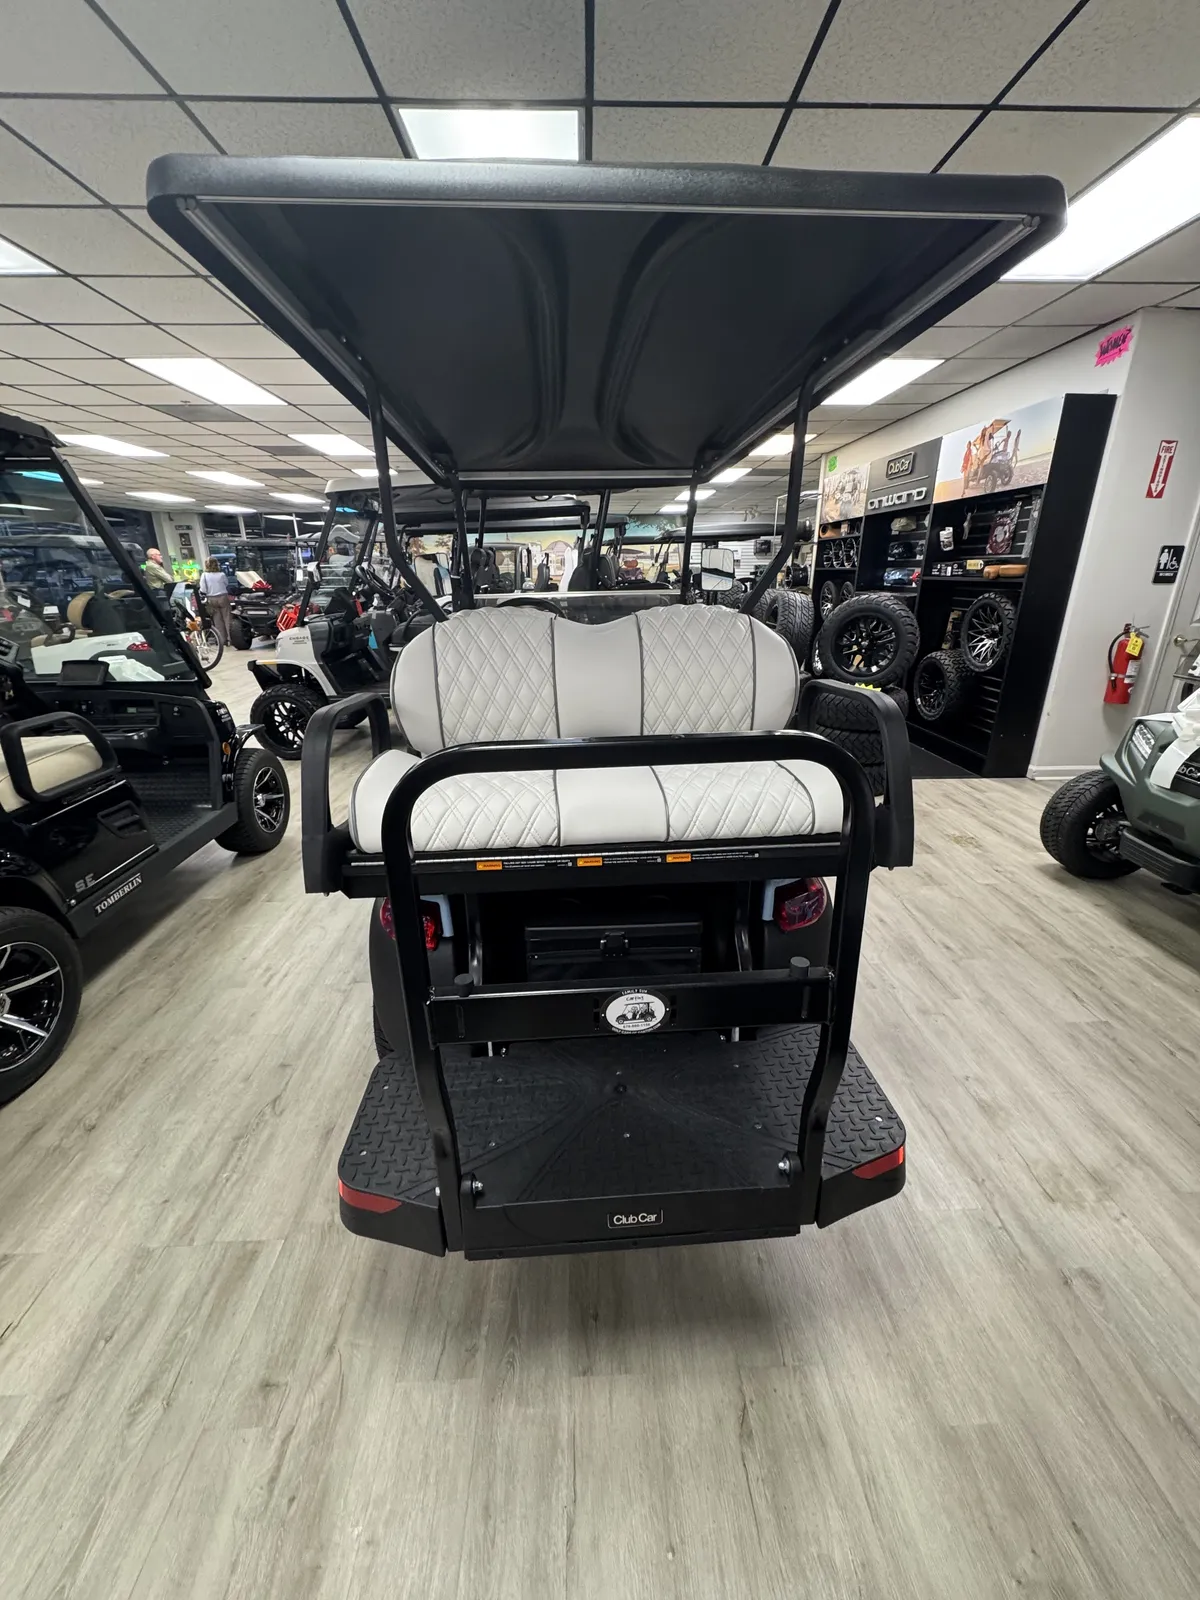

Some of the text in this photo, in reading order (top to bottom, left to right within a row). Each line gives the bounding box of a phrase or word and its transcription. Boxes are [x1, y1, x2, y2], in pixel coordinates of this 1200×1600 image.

[1160, 445, 1175, 454] FIRE
[94, 875, 142, 914] TOMBERLIN
[613, 1212, 657, 1225] Club Car
